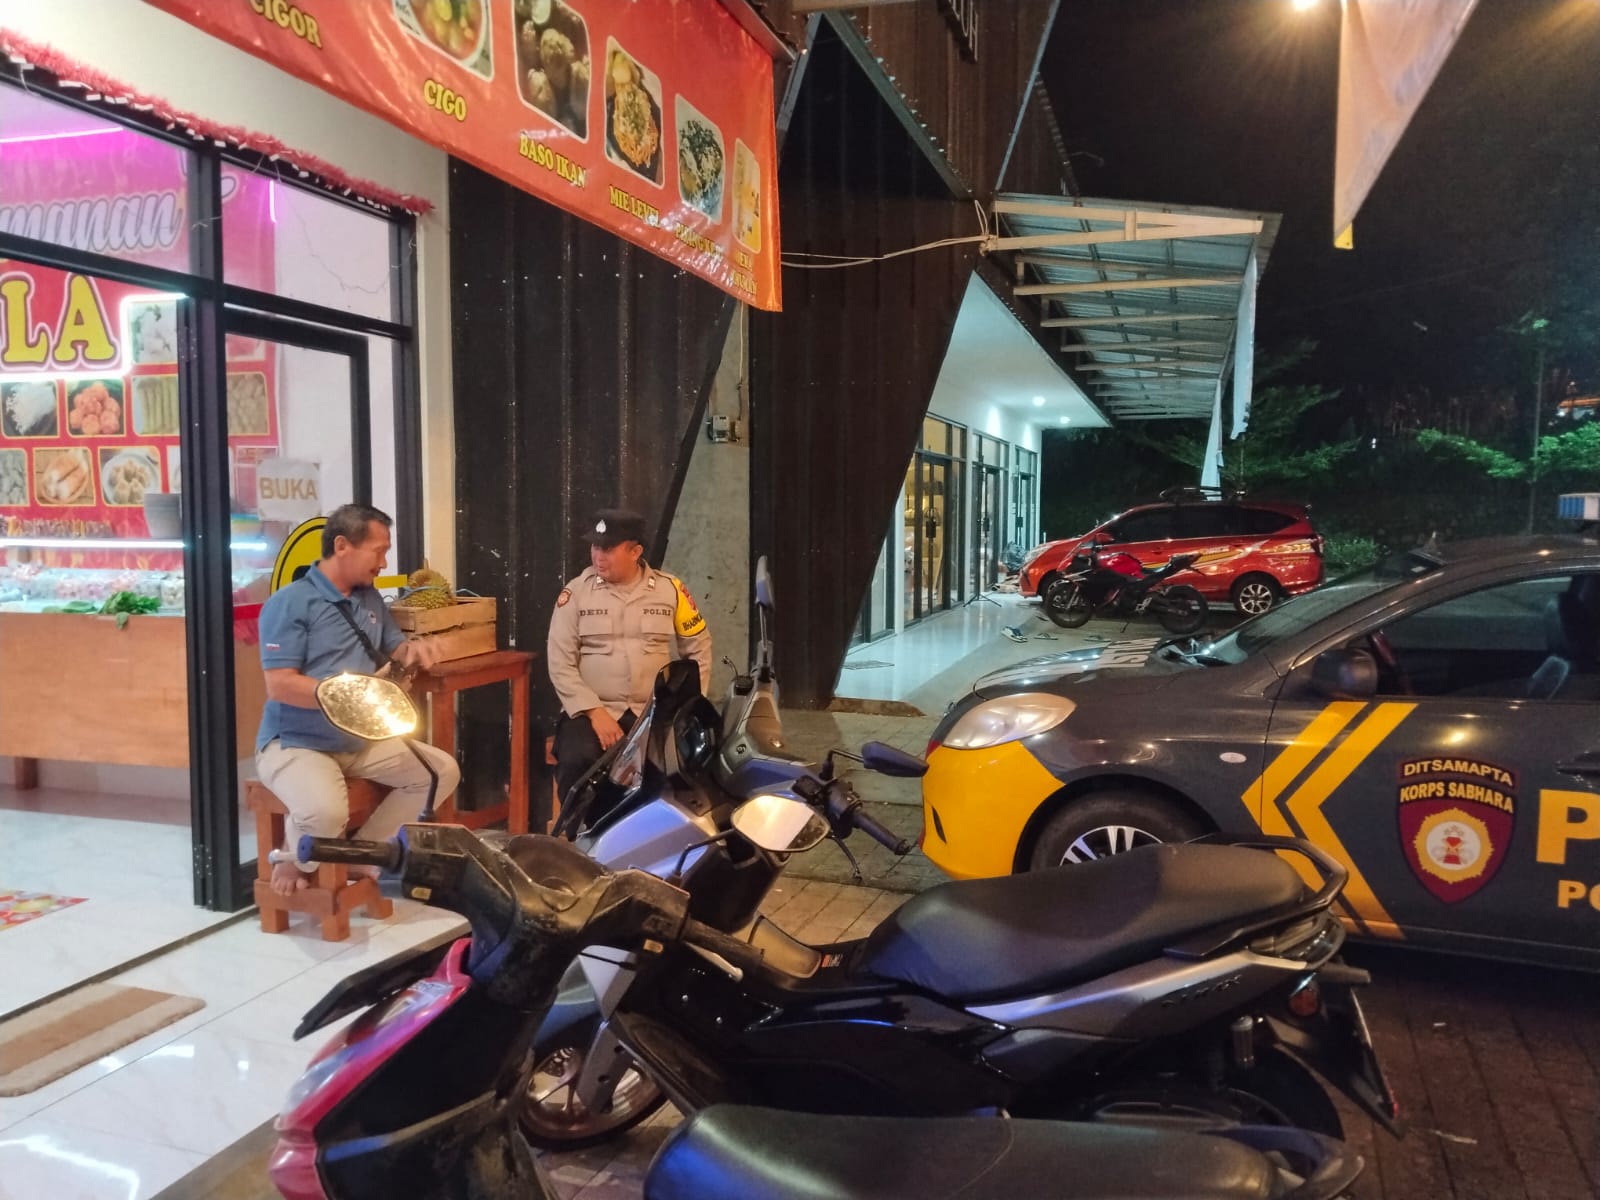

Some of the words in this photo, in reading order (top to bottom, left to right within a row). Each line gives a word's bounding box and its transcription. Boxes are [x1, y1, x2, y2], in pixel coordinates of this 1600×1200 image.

[423, 79, 467, 122] CIGO
[519, 131, 554, 171] BASO
[555, 152, 586, 191] IKAN
[609, 184, 630, 213] MIE
[260, 476, 318, 500] BUKA
[579, 608, 608, 617] DEDI
[642, 608, 671, 617] POLRI
[1403, 759, 1513, 787] DITSAMAPTA
[1400, 781, 1445, 803] KORPS
[1448, 781, 1514, 814] SABHARA
